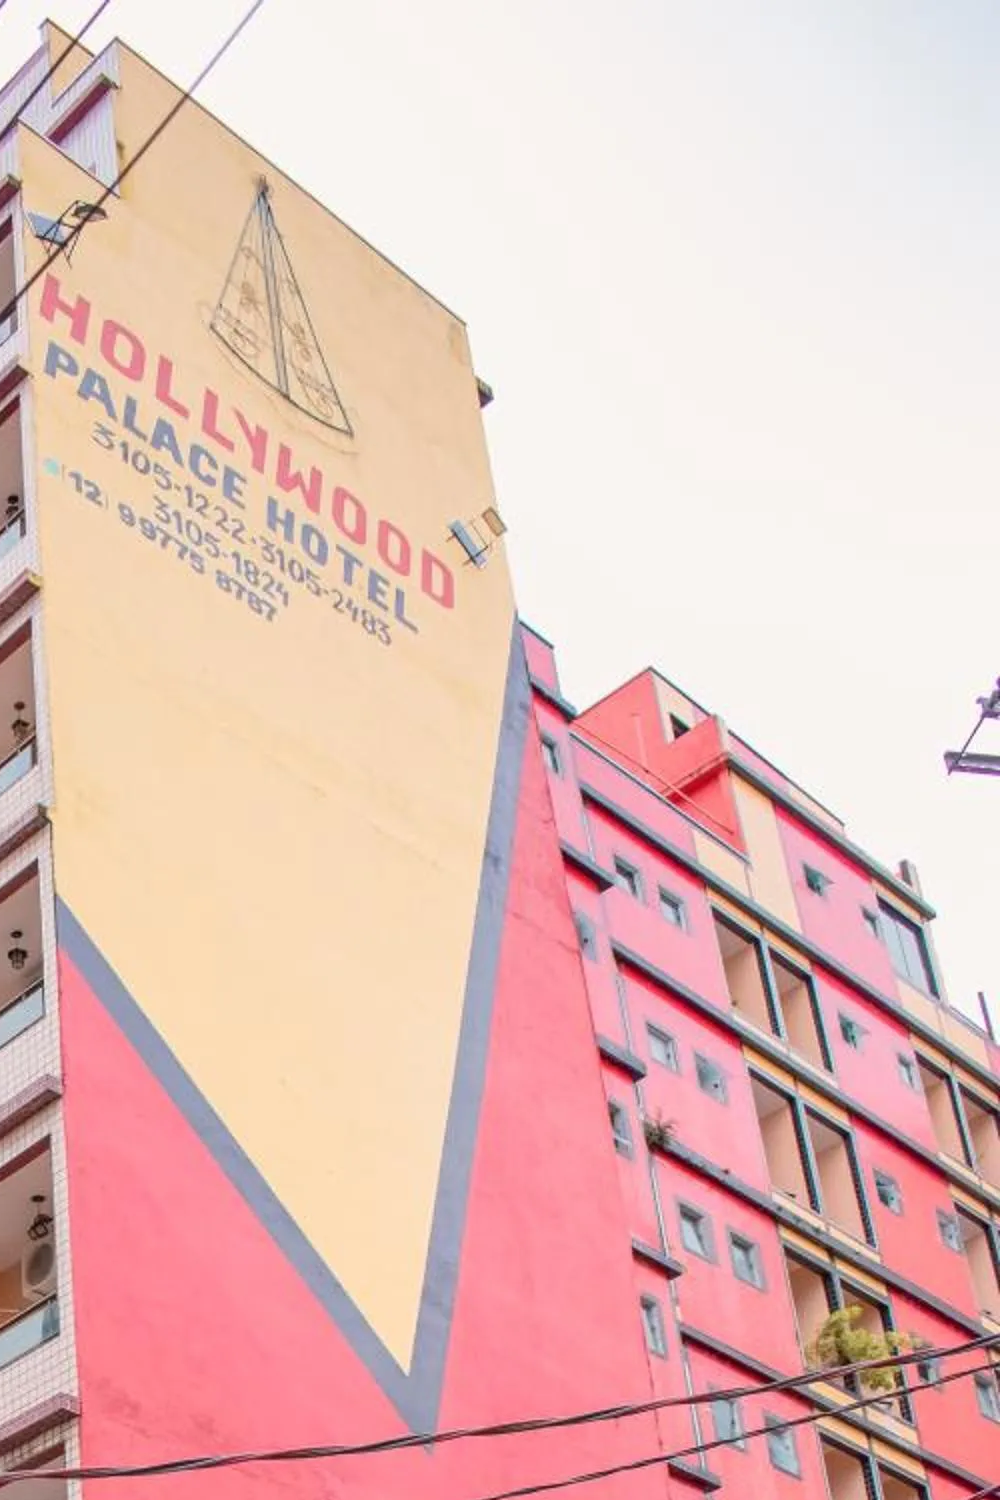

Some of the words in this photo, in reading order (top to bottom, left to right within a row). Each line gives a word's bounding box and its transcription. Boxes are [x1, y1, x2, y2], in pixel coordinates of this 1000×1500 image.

[40, 272, 454, 609] HOLLYWOOD
[44, 339, 247, 510] PALACE
[267, 496, 418, 633] HOTEL
[153, 495, 289, 608] 3105-1824
